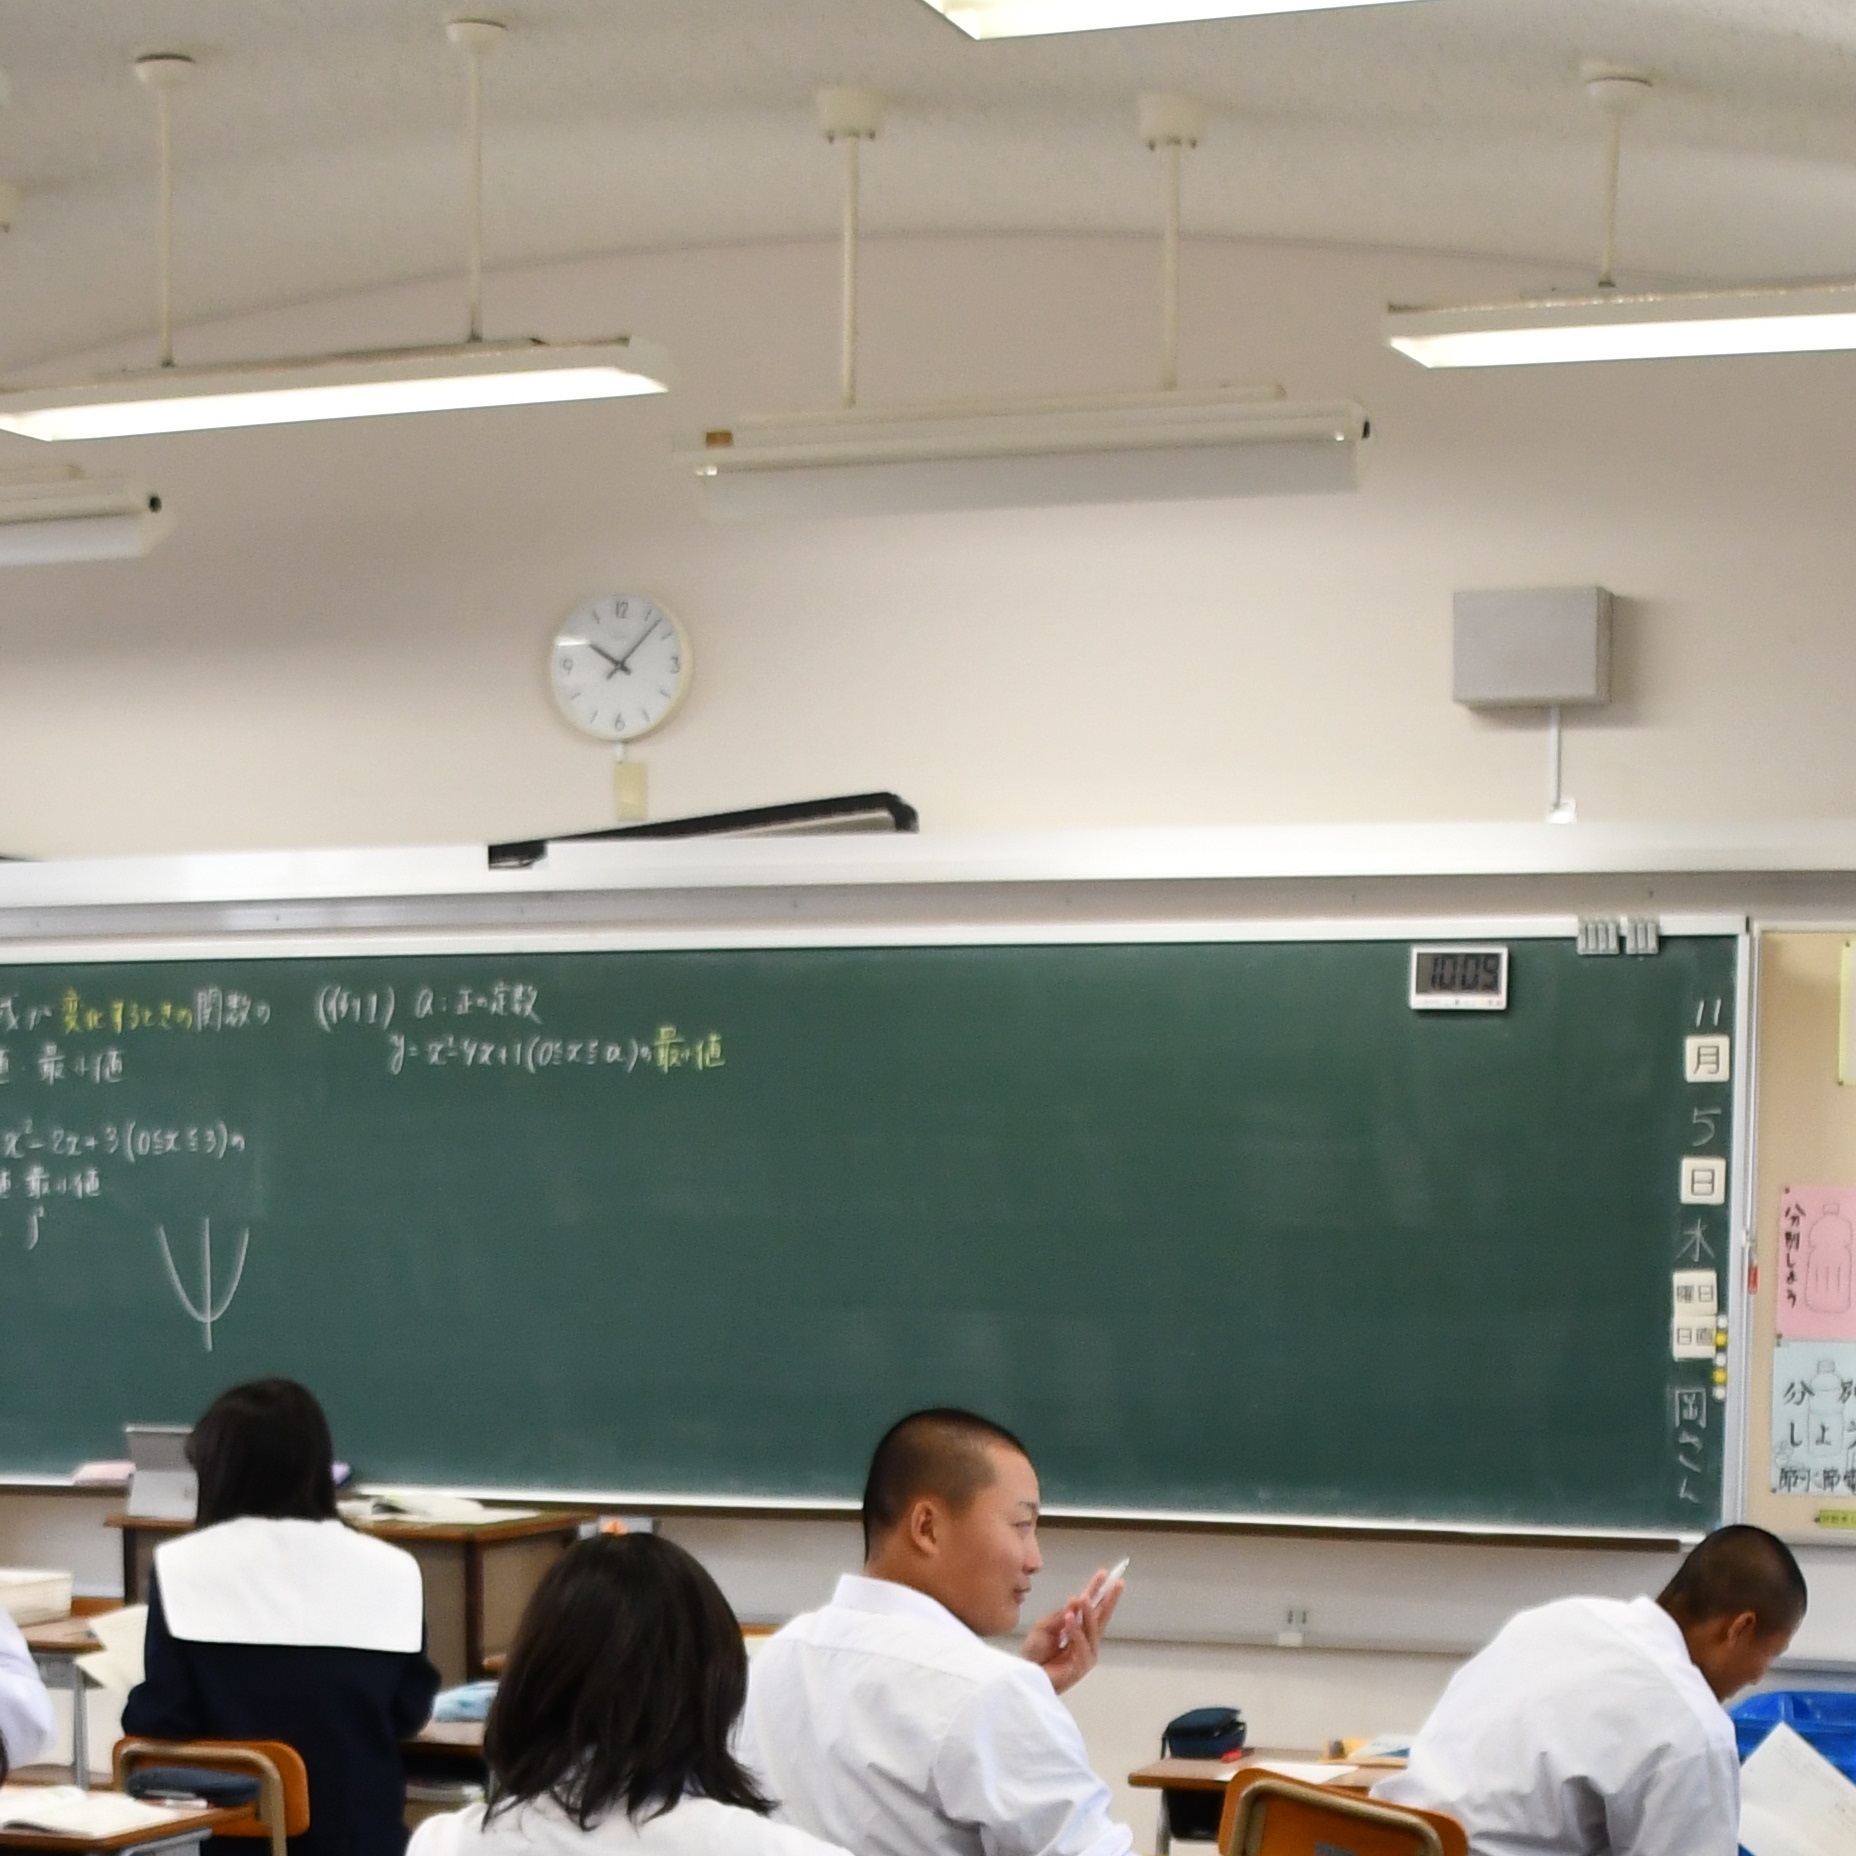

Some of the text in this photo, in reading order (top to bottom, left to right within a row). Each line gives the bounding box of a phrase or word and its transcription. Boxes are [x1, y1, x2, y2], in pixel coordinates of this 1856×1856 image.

[616, 601, 629, 619] 12
[563, 656, 681, 676] 9 3
[614, 712, 626, 732] 6
[1693, 1044, 1721, 1075] 月
[1690, 1106, 1722, 1147] 5
[1691, 1168, 1715, 1196] 日
